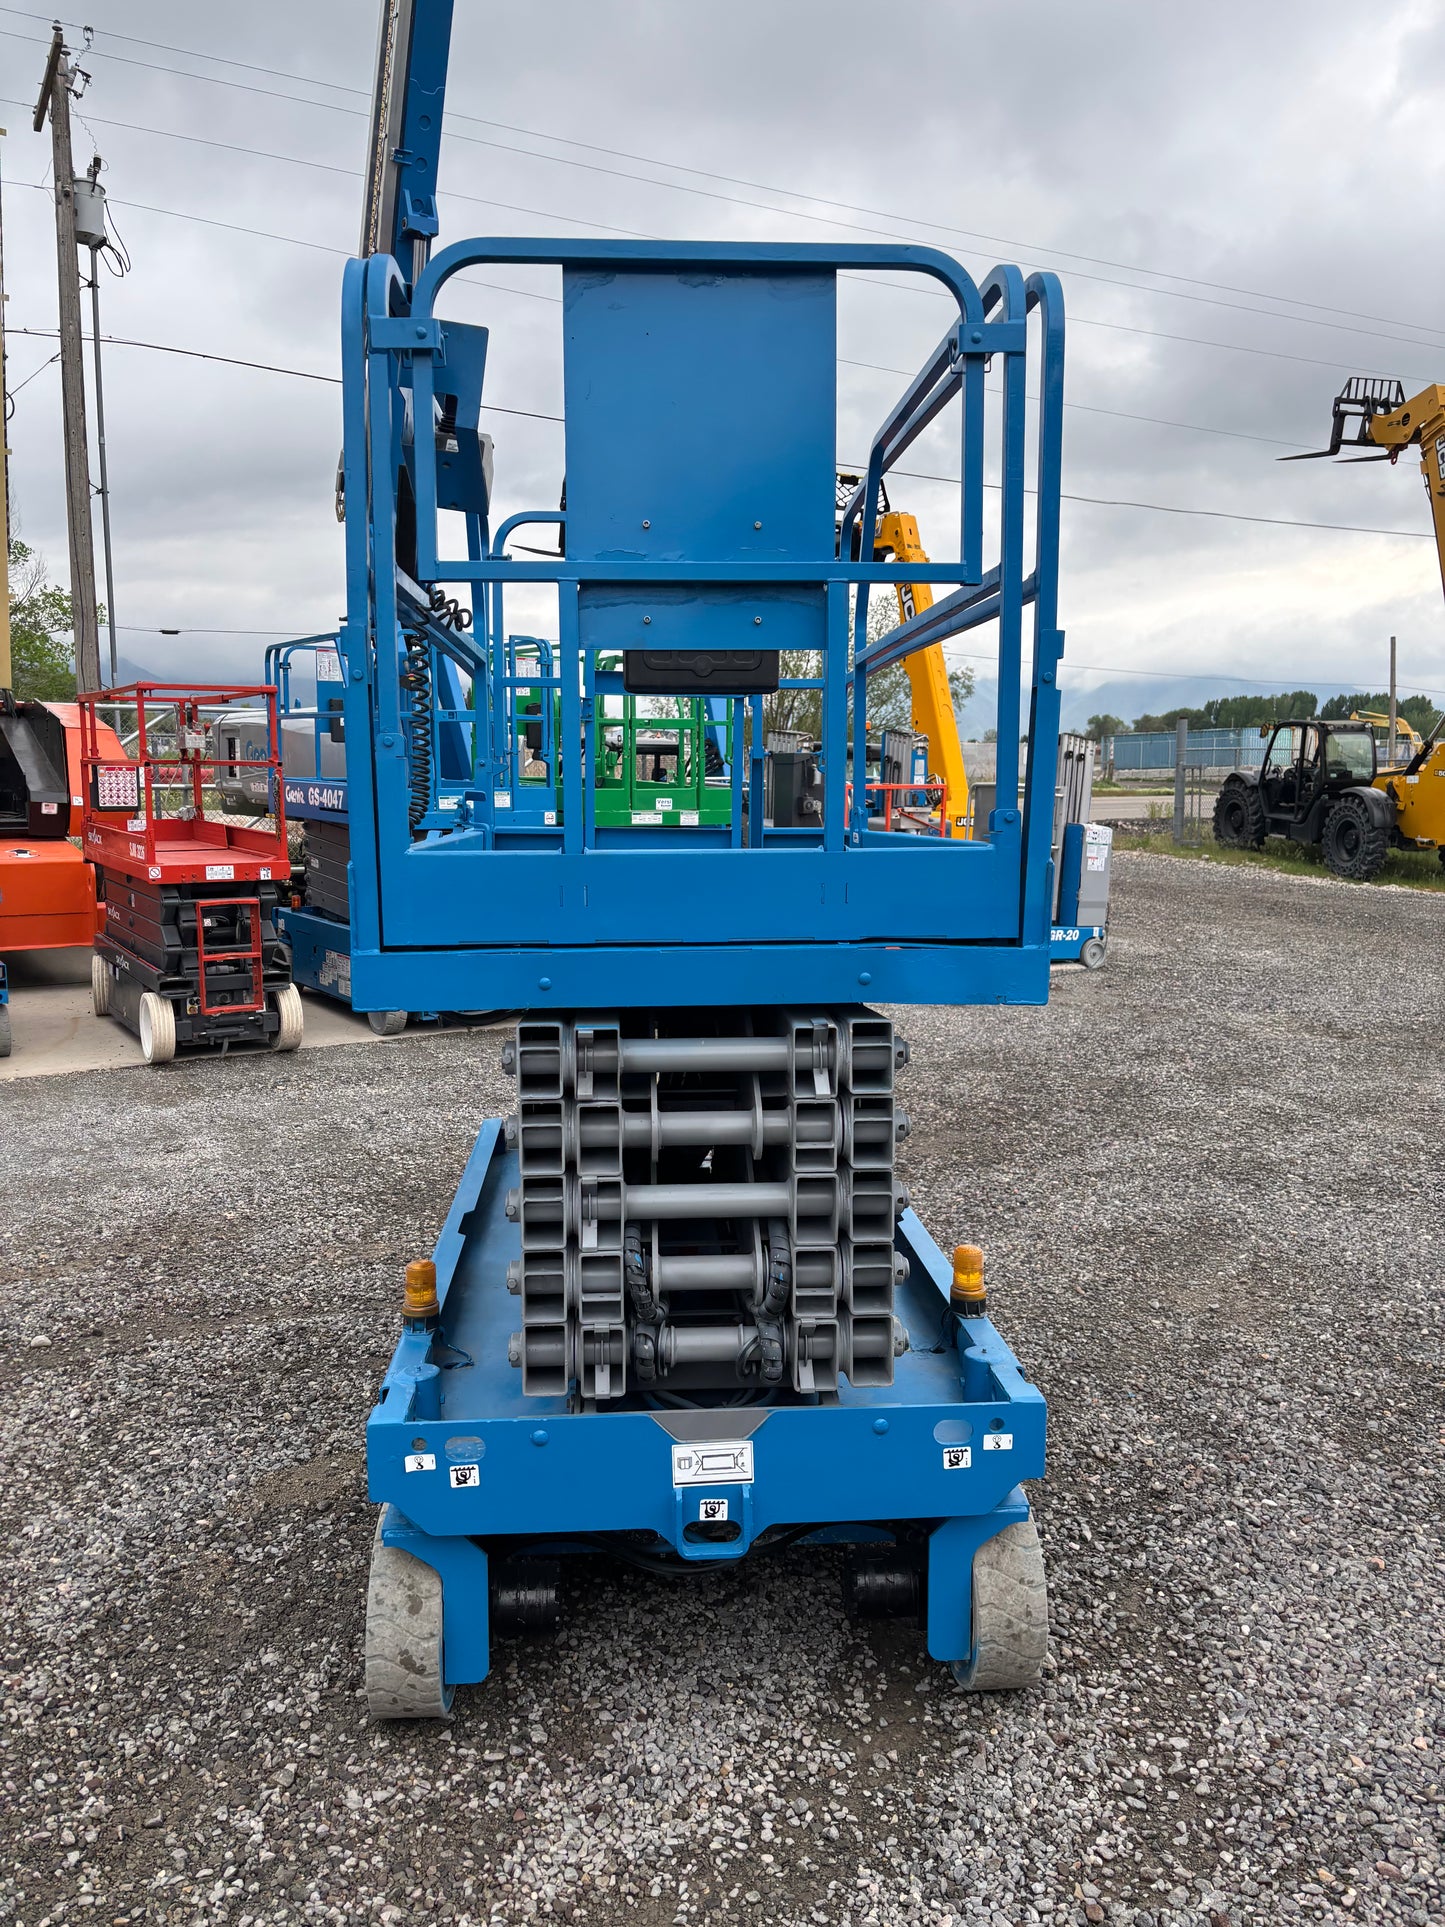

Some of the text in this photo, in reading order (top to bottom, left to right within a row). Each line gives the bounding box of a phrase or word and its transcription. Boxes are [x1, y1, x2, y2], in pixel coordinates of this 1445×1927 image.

[901, 584, 916, 621] JC
[285, 785, 305, 804] Genie
[308, 787, 343, 809] GS-4047
